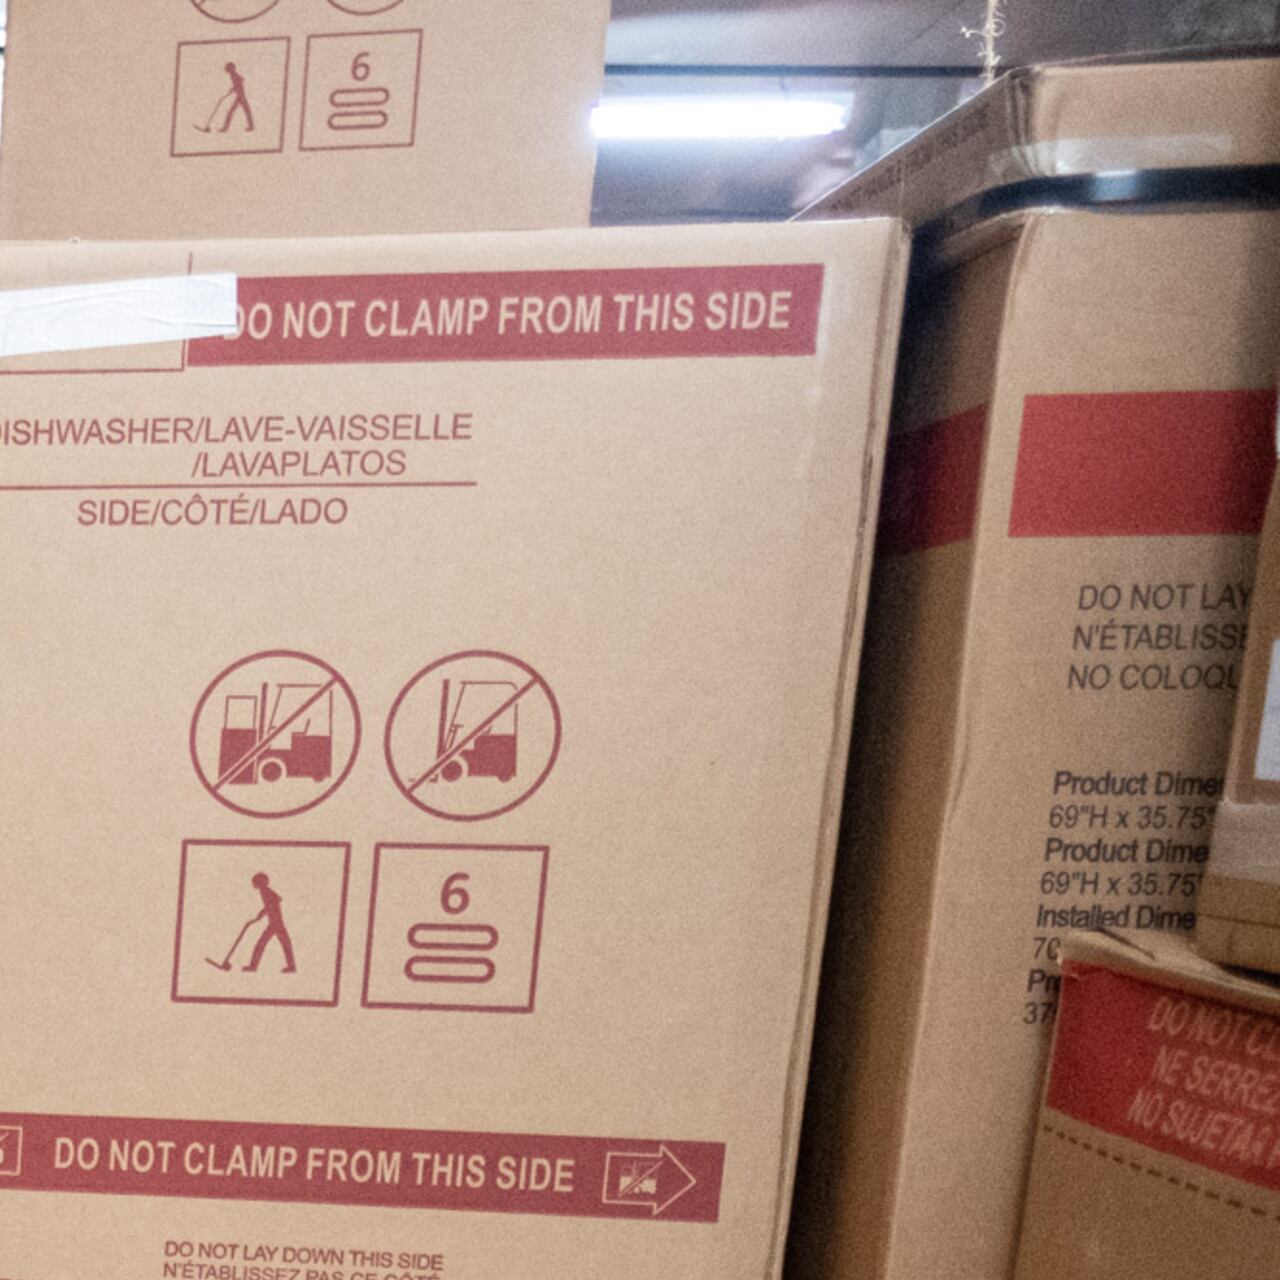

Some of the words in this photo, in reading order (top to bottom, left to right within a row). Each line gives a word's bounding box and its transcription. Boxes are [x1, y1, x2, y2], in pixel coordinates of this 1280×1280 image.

[349, 50, 372, 83] 6
[283, 300, 355, 339] NOT
[365, 298, 489, 338] CLAMP
[499, 295, 602, 335] FROM
[614, 292, 695, 332] THIS
[706, 290, 793, 330] SIDE
[191, 450, 408, 479] /LAVAPLATOS
[77, 492, 350, 528] SIDE/CÔTÉ/LADO
[1078, 584, 1122, 611] DO
[1130, 583, 1194, 611] NOT
[1200, 583, 1253, 611] LAY
[1067, 663, 1111, 691] NO
[1052, 770, 1147, 797] Product
[1044, 836, 1139, 863] Product
[440, 872, 470, 915] 6
[1035, 904, 1130, 929] Installed
[55, 1136, 100, 1170] DO
[109, 1138, 177, 1174] NOT
[183, 1141, 298, 1179] CLAMP
[306, 1147, 402, 1184] FROM
[412, 1151, 487, 1188] THIS
[496, 1155, 576, 1193] SIDE
[164, 1240, 194, 1259] DO
[197, 1242, 240, 1262] NOT
[242, 1244, 281, 1264] LAY
[282, 1245, 347, 1266] DOWN
[349, 1249, 396, 1270] THIS
[398, 1252, 446, 1273] SIDE
